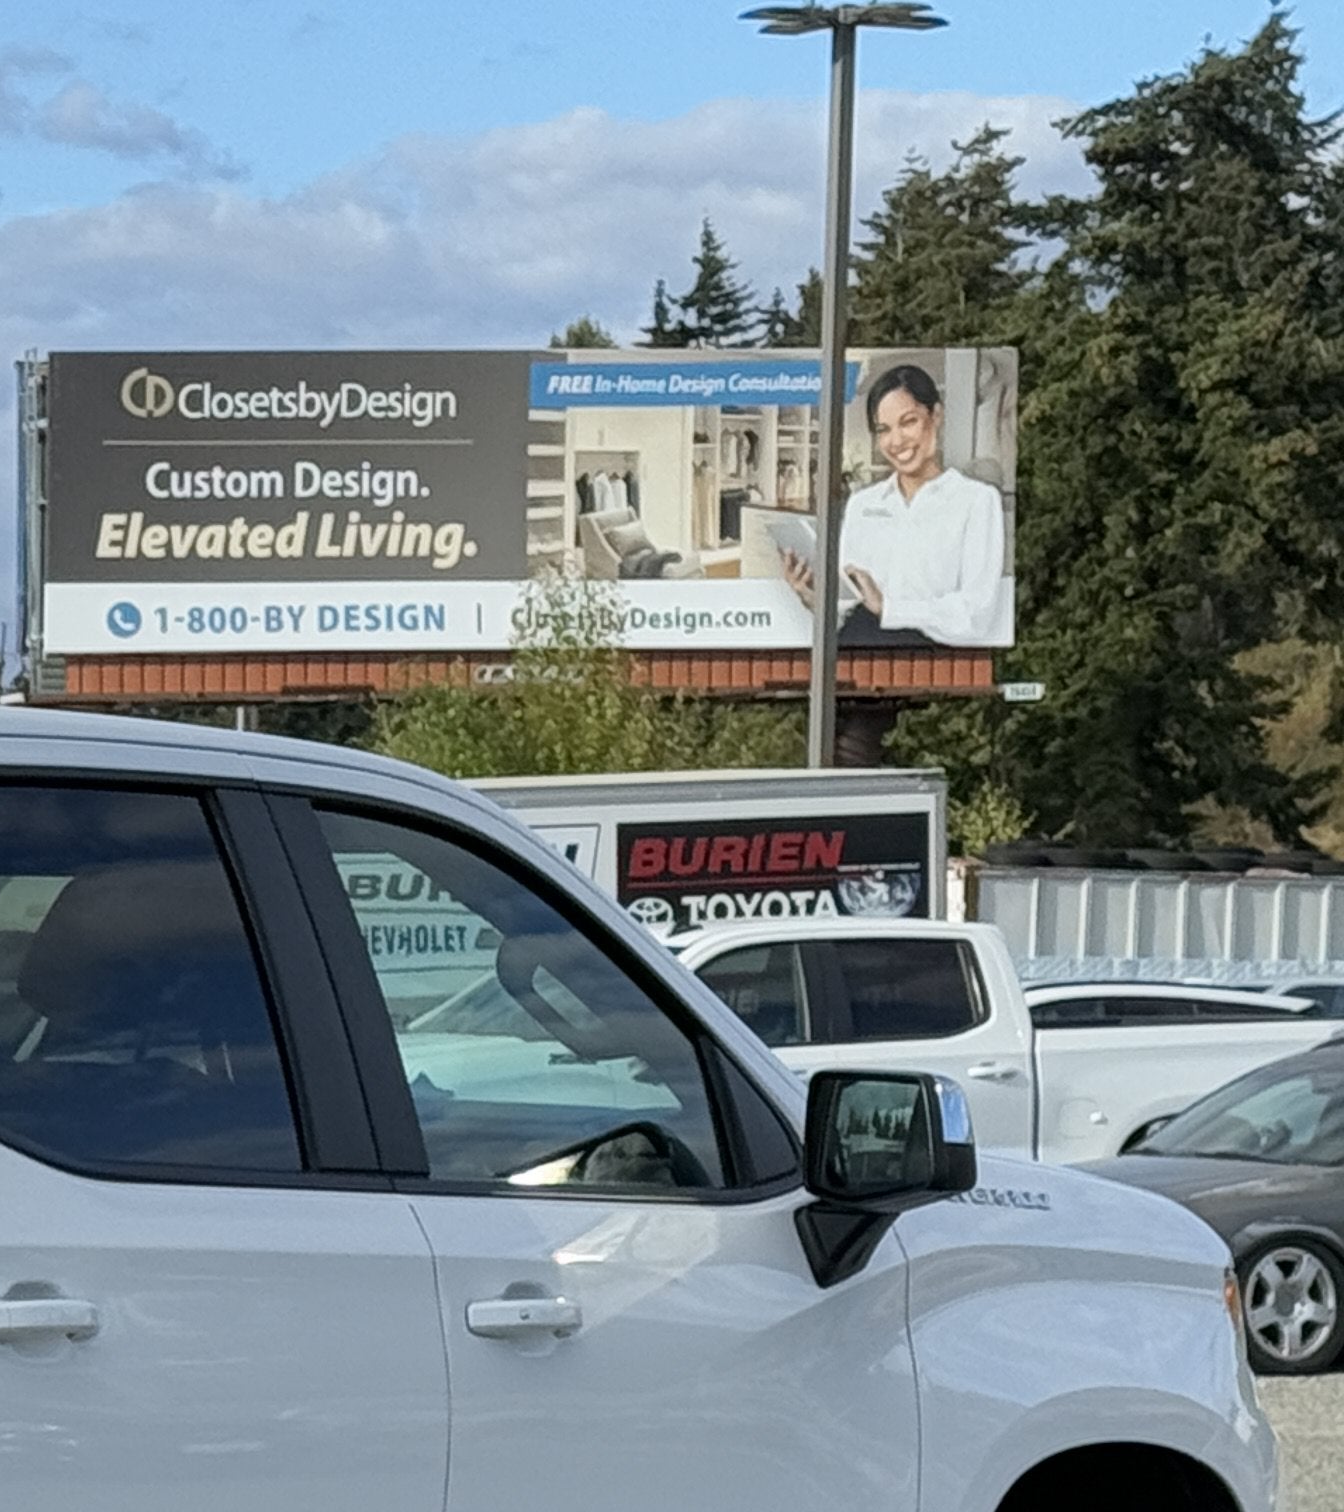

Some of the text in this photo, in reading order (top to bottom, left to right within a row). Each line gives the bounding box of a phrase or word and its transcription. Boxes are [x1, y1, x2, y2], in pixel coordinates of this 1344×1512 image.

[177, 381, 457, 428] ClosetsbyDesign
[547, 372, 823, 397] FREE In-Home Design Consultatio
[145, 461, 431, 506] Custom Design.
[95, 511, 479, 569] Elevated Living.
[153, 604, 446, 635] 1-800-BY DESIGN
[628, 830, 845, 877] BURIEN
[681, 890, 839, 926] TOYOTA
[363, 924, 468, 957] EVROLET
